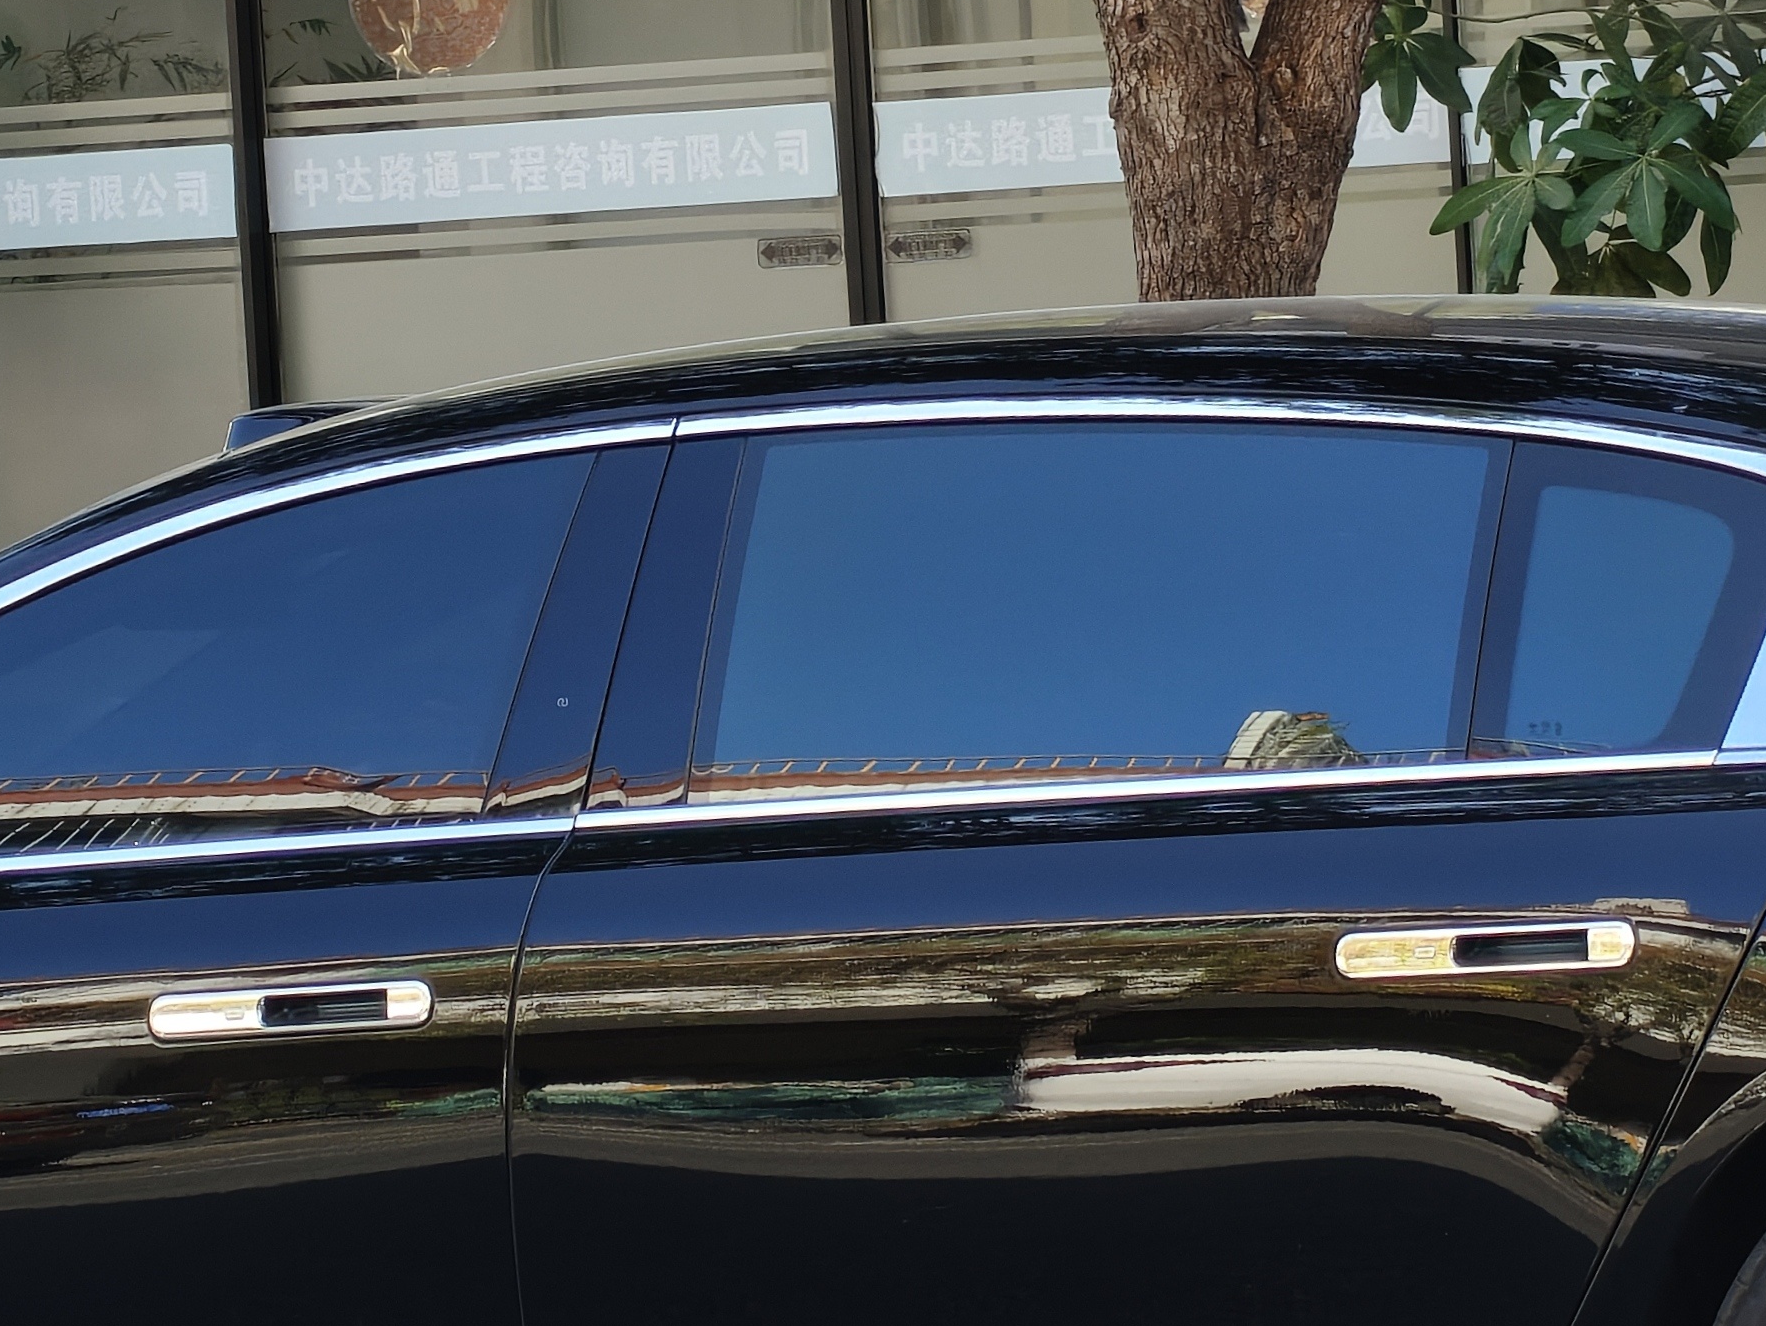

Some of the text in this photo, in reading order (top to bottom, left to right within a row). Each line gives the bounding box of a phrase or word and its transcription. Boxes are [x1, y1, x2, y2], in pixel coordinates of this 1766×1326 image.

[293, 128, 810, 209] 中达路通工程咨询有限公司
